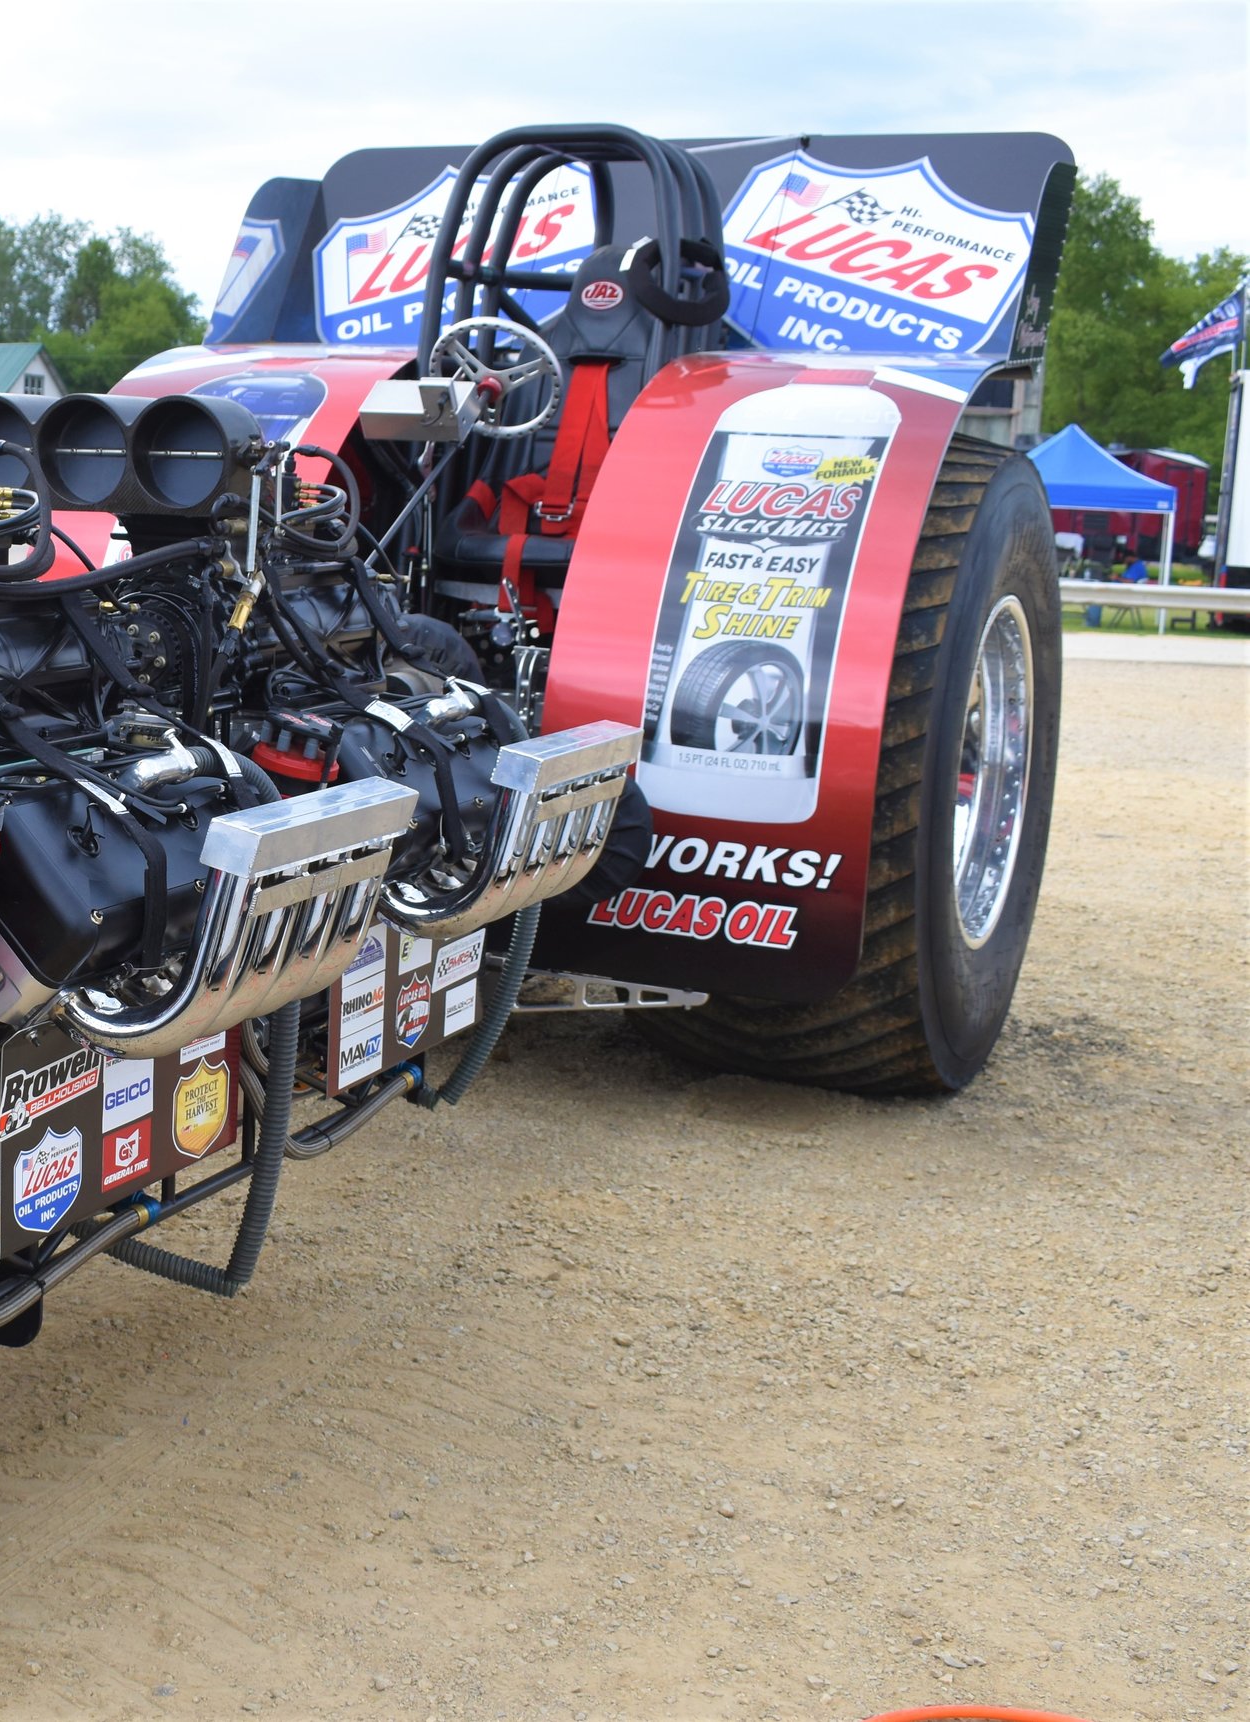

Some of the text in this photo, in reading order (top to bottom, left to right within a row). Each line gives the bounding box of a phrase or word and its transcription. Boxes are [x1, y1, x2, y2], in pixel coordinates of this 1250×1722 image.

[900, 205, 923, 219] HI-
[891, 219, 1017, 263] PERFORMANCE
[743, 213, 999, 299] LUCAS
[584, 283, 619, 299] JAZ
[337, 311, 392, 340] OIL
[773, 275, 963, 351] PRODUCTS
[815, 465, 876, 480] FORMULA
[834, 459, 863, 469] NEW
[698, 480, 863, 520] LUCAS
[705, 552, 820, 574] FAST & EASY
[692, 604, 802, 639] SHINE
[692, 753, 703, 765] PT
[721, 757, 731, 768] FL
[750, 759, 768, 772] 710
[587, 887, 798, 950] LUCAS OIL
[30, 1073, 95, 1112] BELLHOUSING
[105, 1078, 150, 1111] GEICO
[184, 1080, 219, 1102] PROTECT
[197, 1094, 206, 1106] THE
[185, 1098, 219, 1121] HARVEST
[51, 1142, 79, 1160] PERFORMANCE
[22, 1151, 78, 1199] LUCAS
[104, 1166, 134, 1185] GENERAL
[18, 1180, 79, 1218] OIL PRODUCTS
